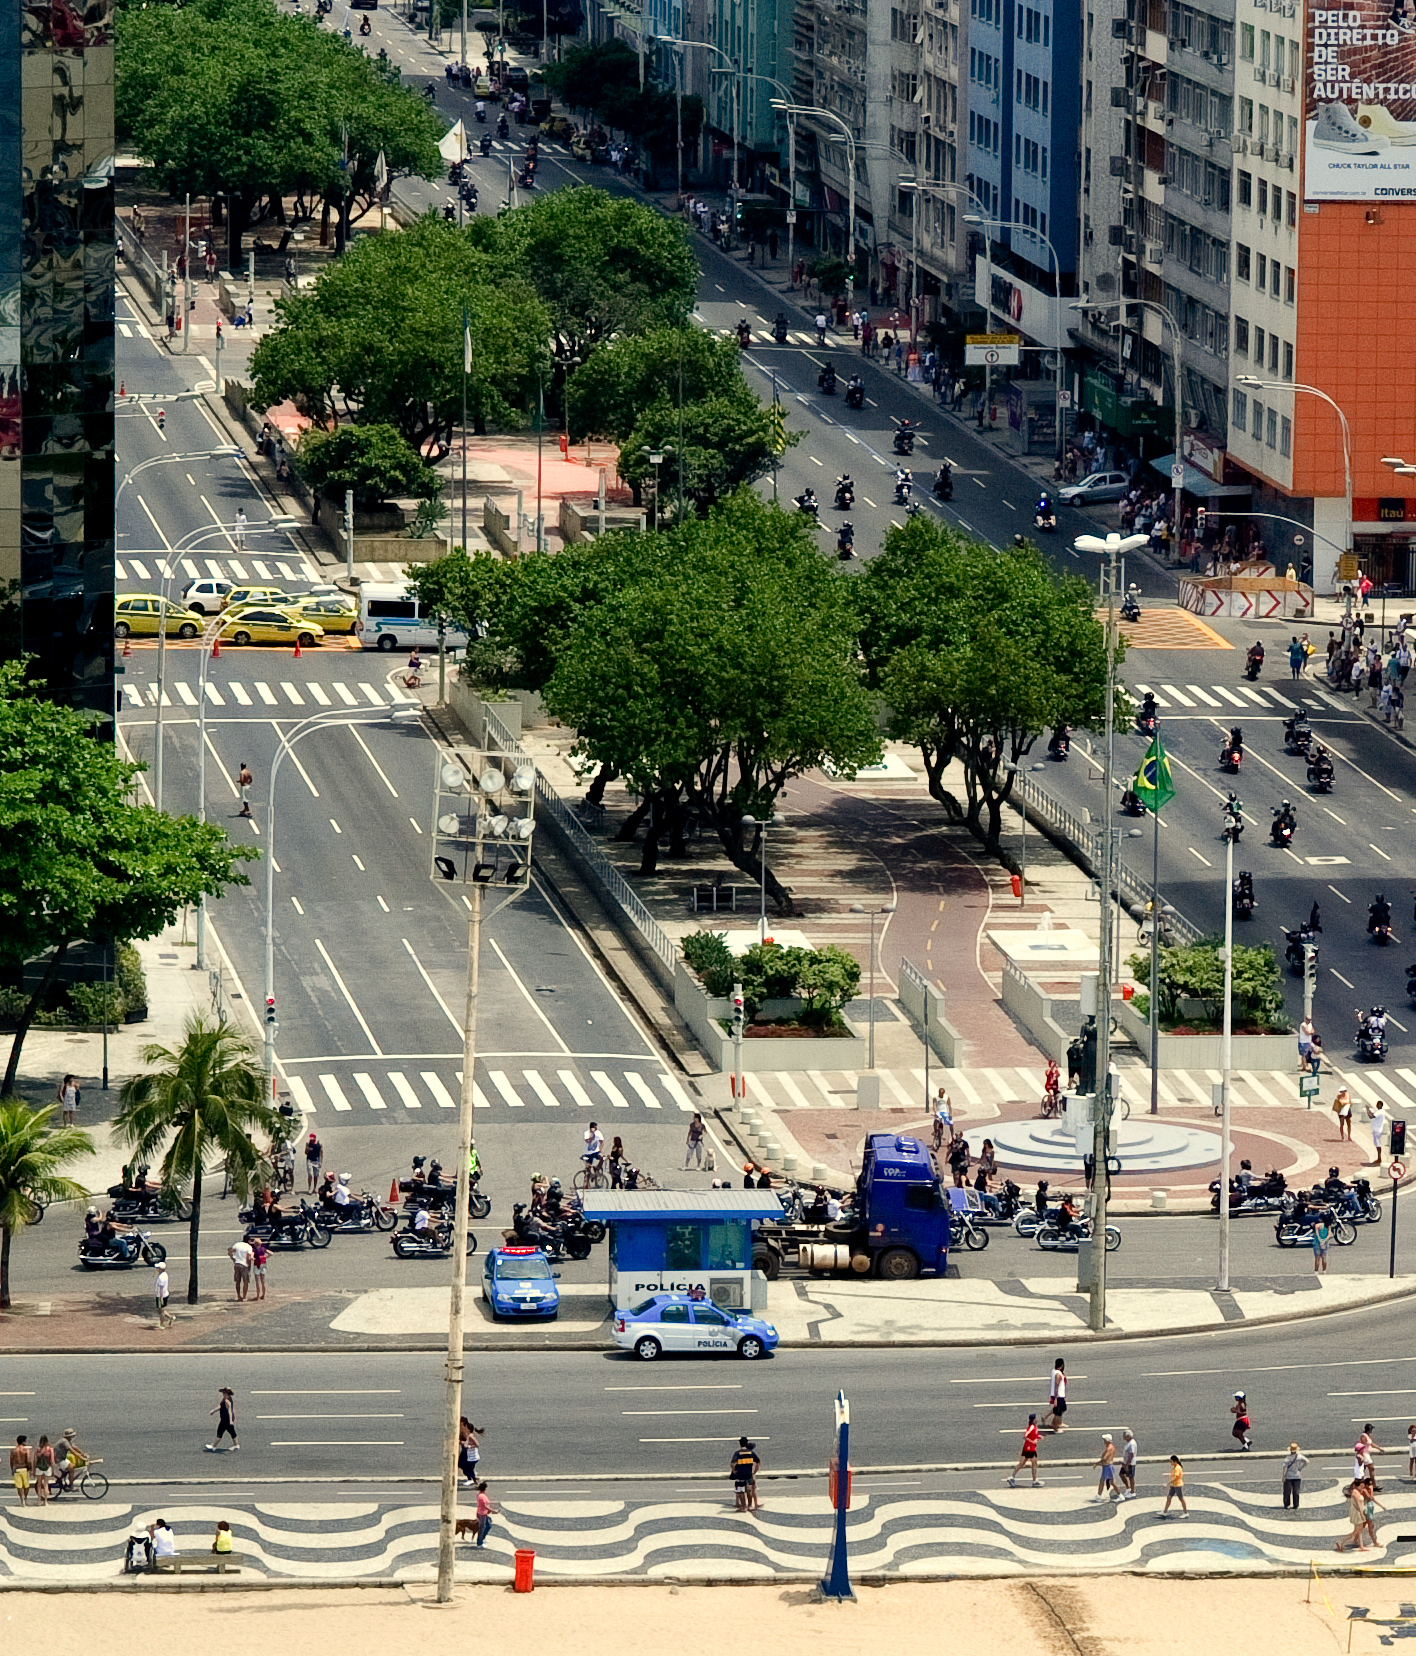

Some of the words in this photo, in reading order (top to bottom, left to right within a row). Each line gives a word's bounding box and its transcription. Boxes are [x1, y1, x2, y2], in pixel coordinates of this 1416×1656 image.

[1314, 10, 1361, 27] PELO
[1314, 28, 1399, 45] DIREITO
[1314, 46, 1338, 63] DE
[1313, 64, 1351, 81] SER
[1381, 508, 1404, 518] Itaú
[635, 1282, 706, 1292] POLÍCIA
[697, 1339, 728, 1348] POLÍCIA
